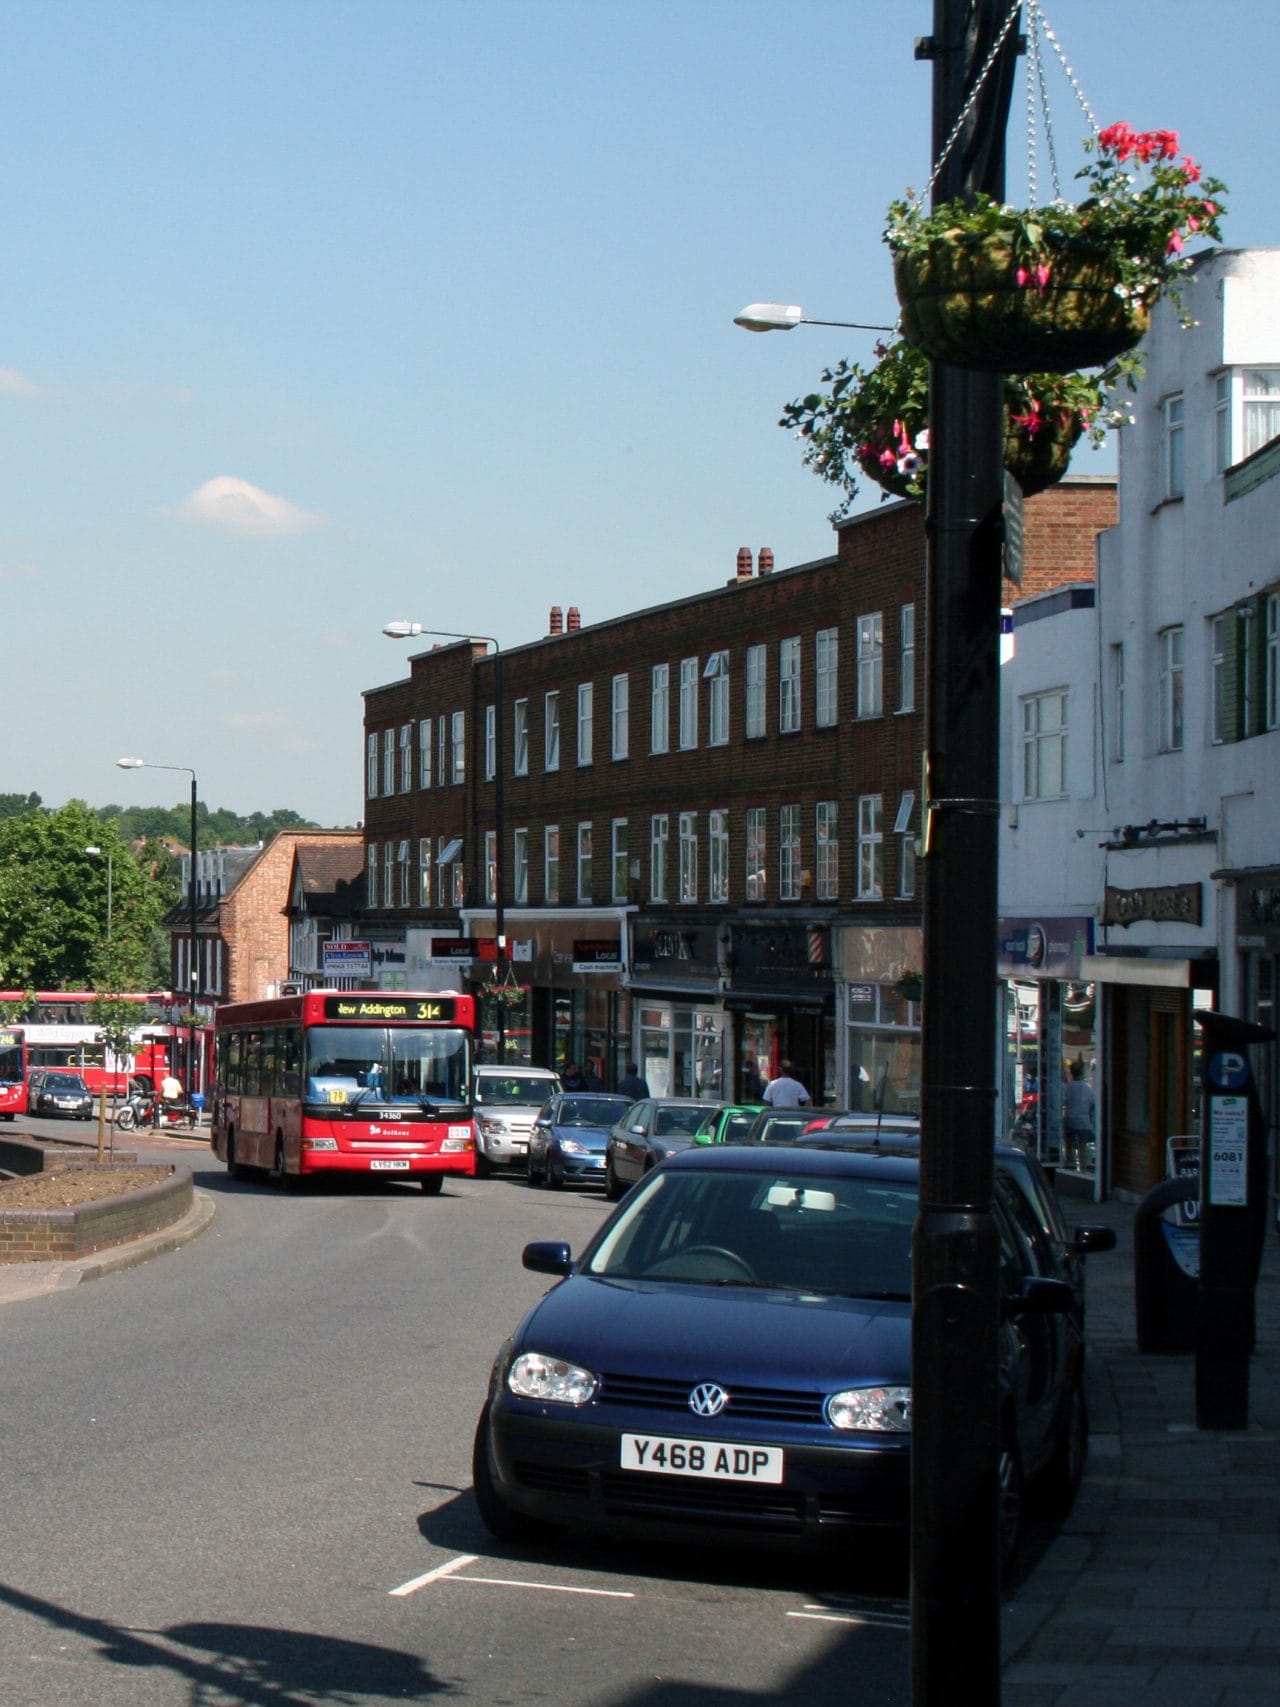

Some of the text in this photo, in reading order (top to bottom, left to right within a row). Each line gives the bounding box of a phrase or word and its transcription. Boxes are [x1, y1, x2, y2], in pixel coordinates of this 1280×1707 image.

[595, 951, 618, 960] Local
[360, 1003, 405, 1018] Addington
[0, 1035, 15, 1045] 246
[1222, 1053, 1243, 1086] P
[1213, 1151, 1243, 1162] 6081
[634, 1439, 768, 1476] Y468 ADP
